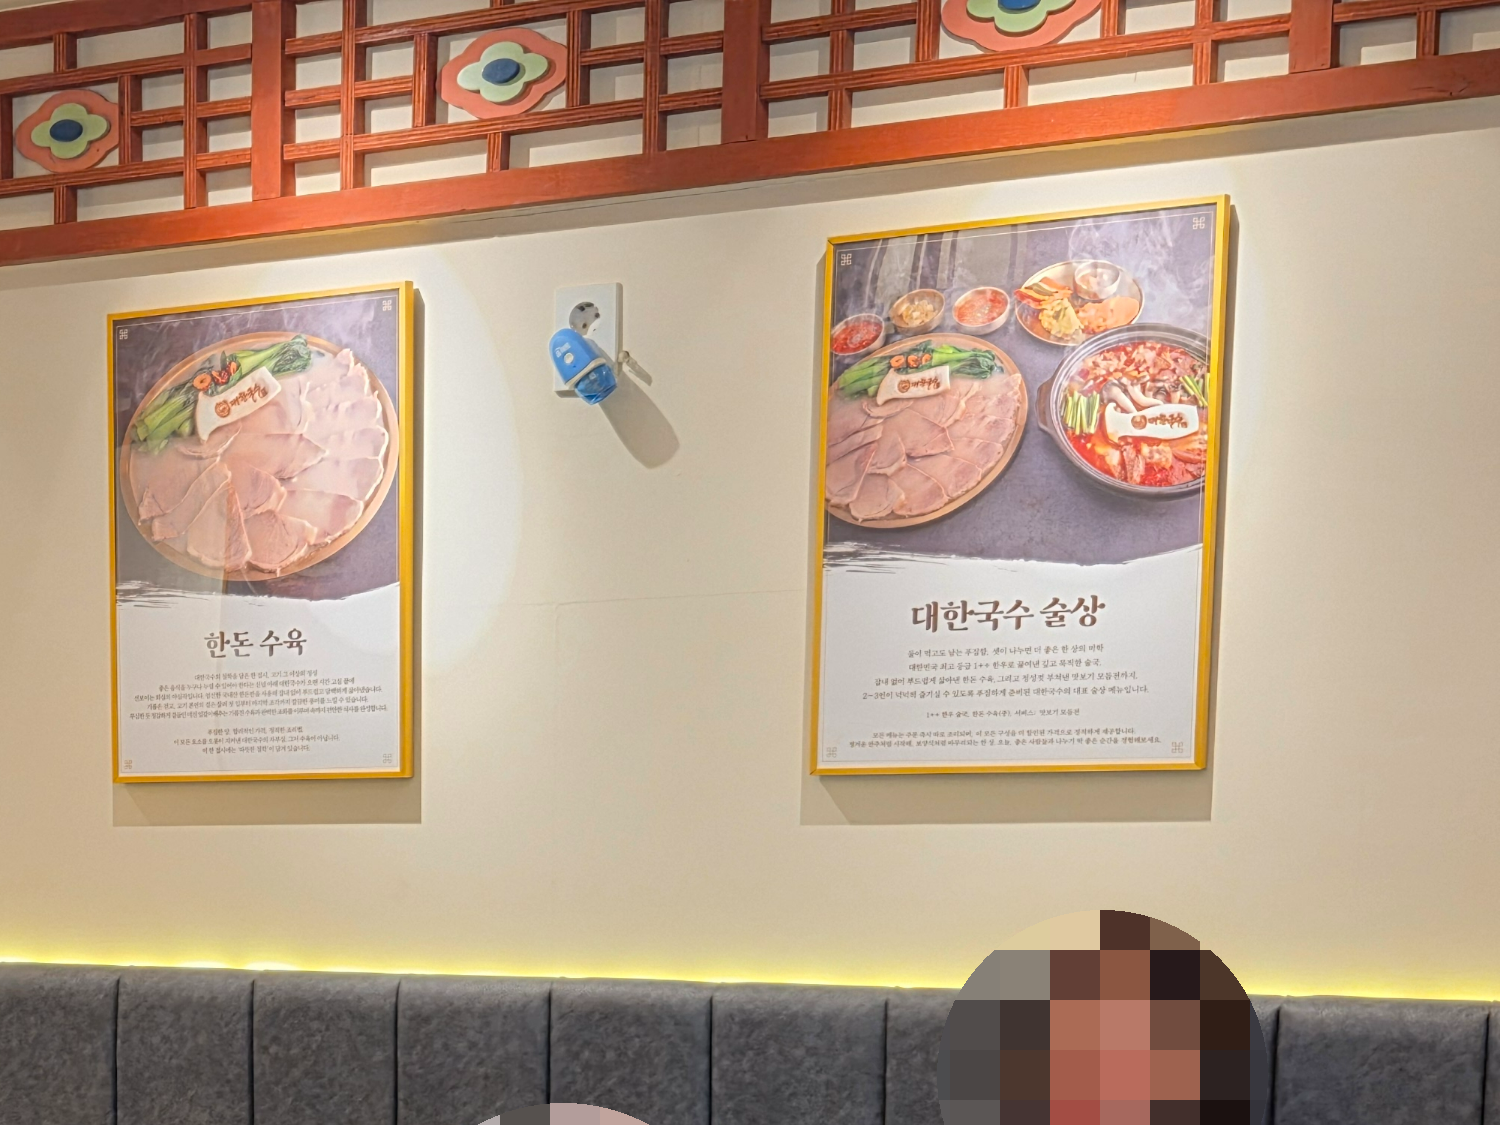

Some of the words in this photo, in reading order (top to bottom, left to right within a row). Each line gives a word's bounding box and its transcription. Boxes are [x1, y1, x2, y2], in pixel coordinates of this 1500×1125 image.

[912, 600, 1034, 633] 대한국수
[1040, 595, 1106, 628] 술상
[204, 630, 254, 659] 한돈
[259, 628, 308, 657] 수육
[923, 648, 946, 657] 먹고도
[948, 648, 962, 656] 남는
[992, 647, 1006, 655] 셋이
[1009, 646, 1032, 655] 나누면
[1043, 645, 1058, 654] 좋은
[1070, 645, 1086, 653] 상의
[908, 662, 938, 672] 대한민국
[939, 662, 954, 671] 최고
[956, 661, 971, 670] 등급
[973, 661, 989, 669] 1++
[992, 660, 1015, 669] 한우로
[1042, 658, 1056, 667] 깊고
[1058, 657, 1082, 666] 묵직한
[194, 672, 220, 681] 대한국수의
[874, 677, 888, 685] 잡내
[890, 677, 904, 685] 없이
[906, 676, 936, 685] 부드럽게
[938, 676, 960, 684] 삶아낸
[962, 675, 977, 684] 한돈
[996, 675, 1019, 683] 그리고
[1046, 674, 1069, 682] 부쳐낸
[1071, 673, 1094, 682] 맛보기
[952, 689, 973, 697] 있도록
[975, 689, 1006, 697] 푸짐하게
[1008, 688, 1030, 696] 준비된
[1032, 687, 1070, 695] 대한국수의
[1072, 687, 1088, 695] 대표
[1090, 686, 1105, 694] 술상
[1107, 686, 1149, 694] 메뉴입니다.
